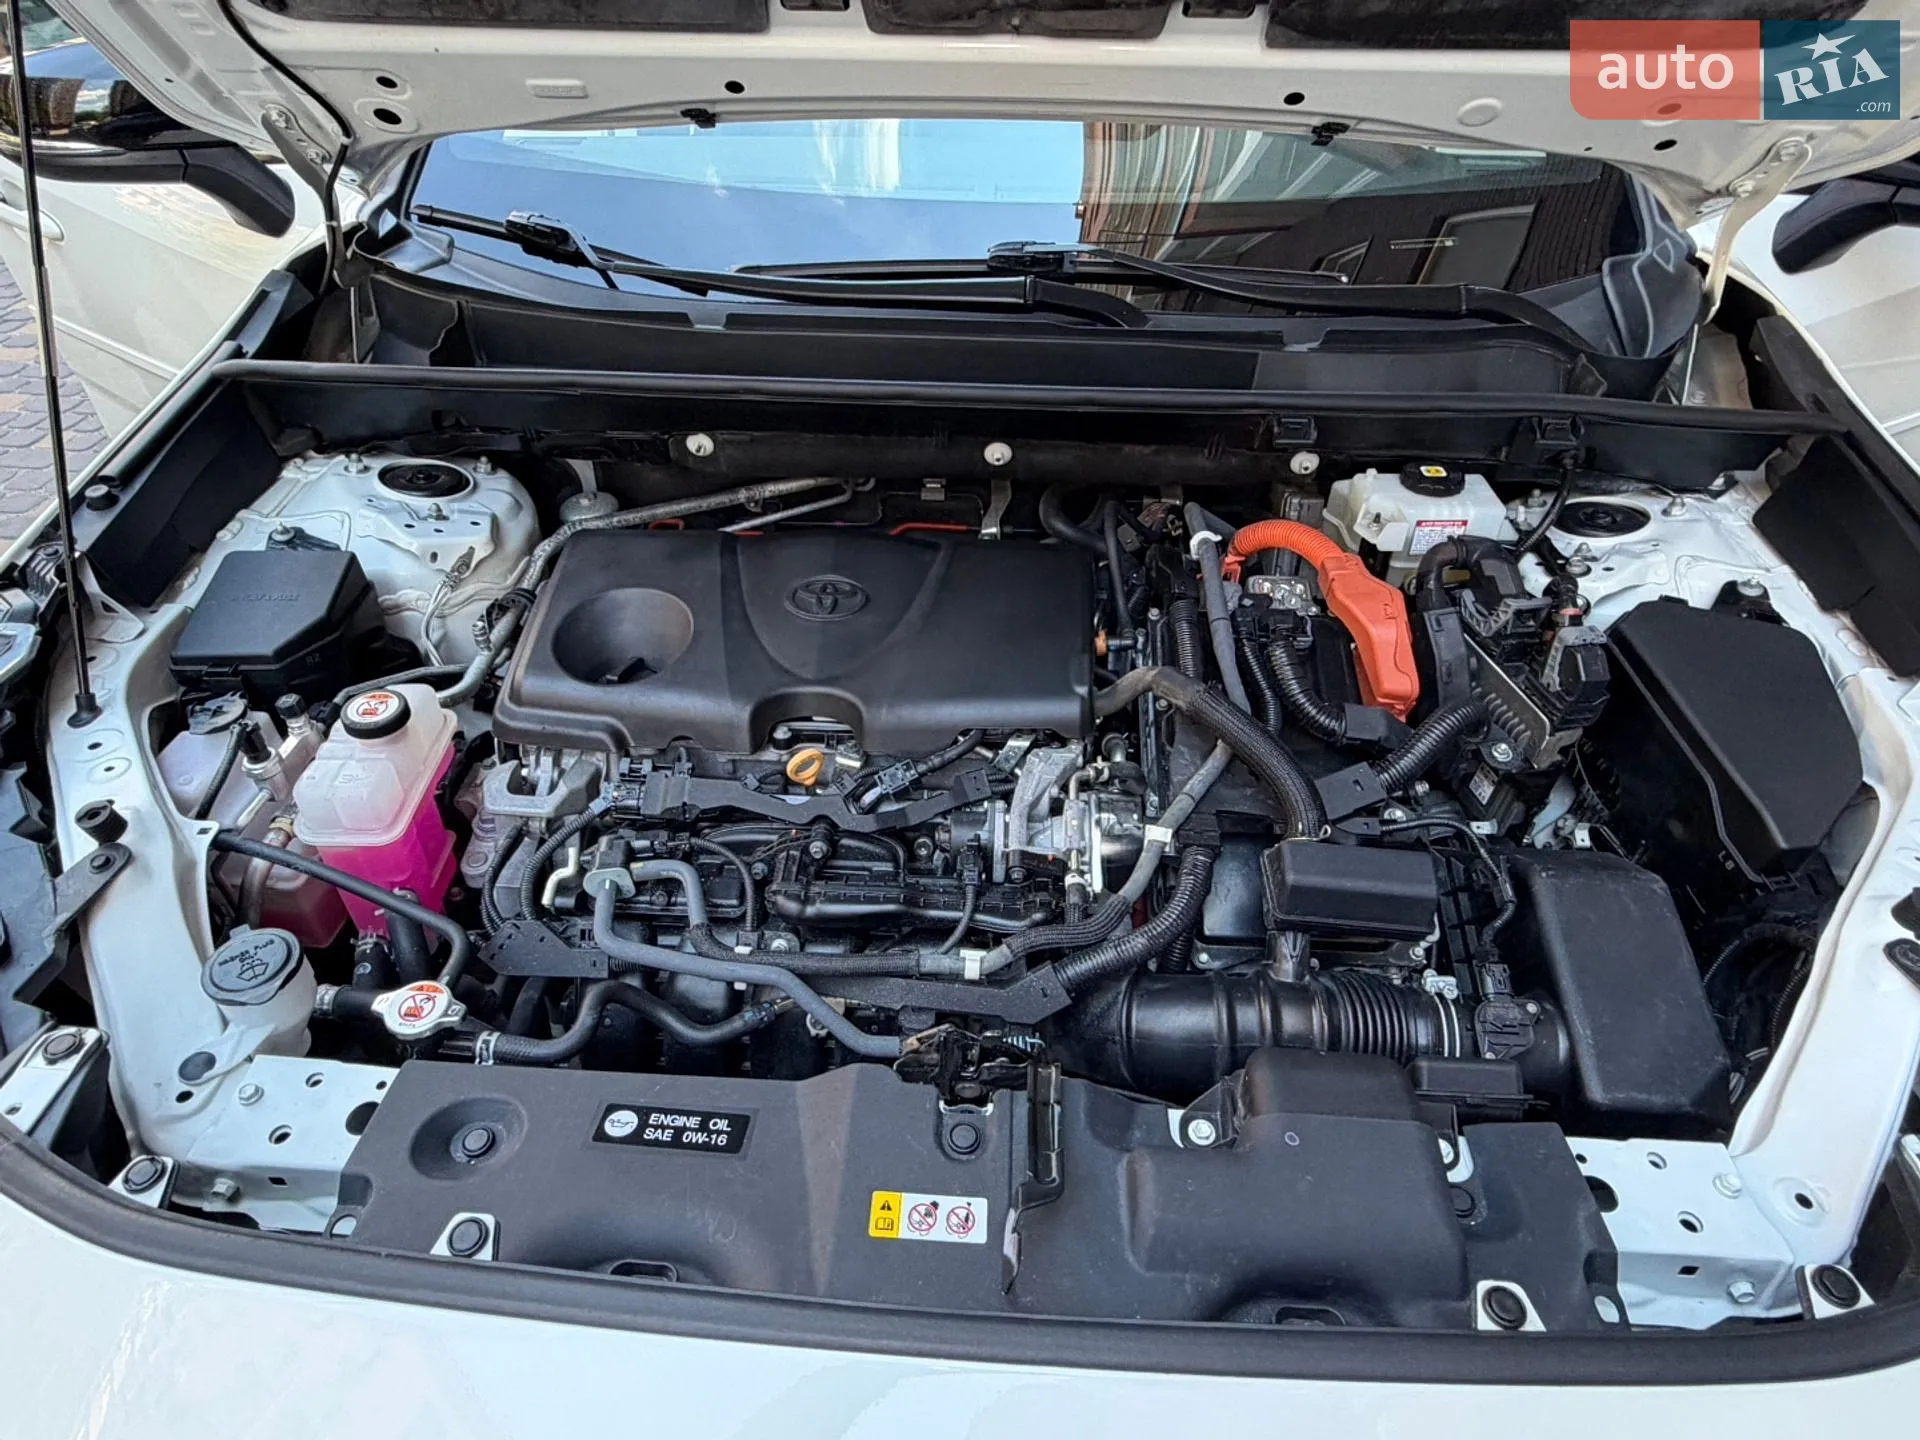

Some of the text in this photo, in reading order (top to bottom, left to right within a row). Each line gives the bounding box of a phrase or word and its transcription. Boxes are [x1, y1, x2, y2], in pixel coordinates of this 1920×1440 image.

[648, 1113, 733, 1132] ENGINE OIL
[643, 1127, 728, 1147] SAE 0W-16
